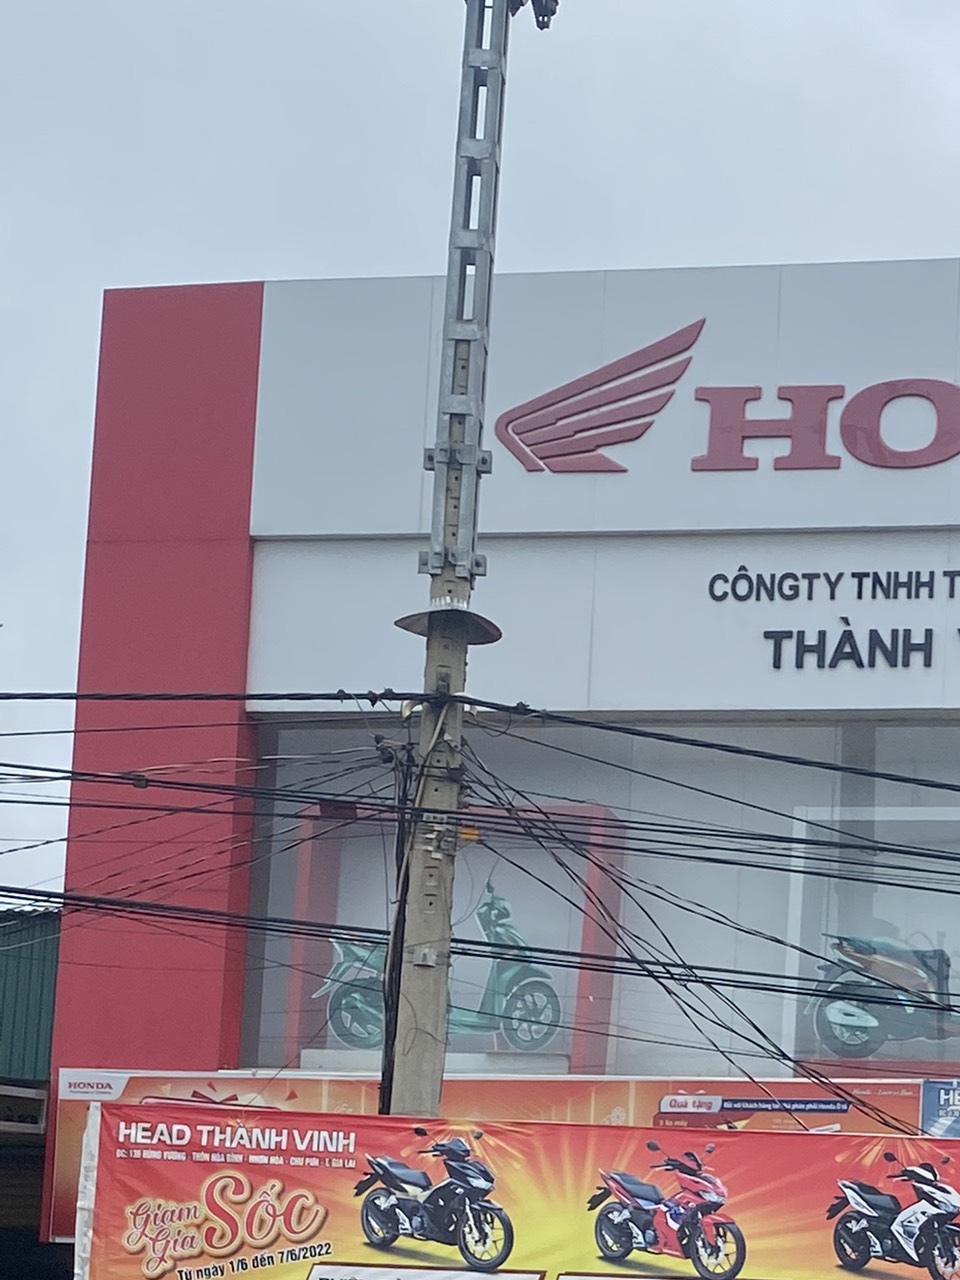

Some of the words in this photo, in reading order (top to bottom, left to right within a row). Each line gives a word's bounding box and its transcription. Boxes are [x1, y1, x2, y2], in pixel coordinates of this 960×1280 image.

[851, 571, 935, 599] TNHH
[763, 616, 933, 669] THÀNH
[68, 1081, 113, 1090] HONDA
[118, 1121, 191, 1146] HEAD
[196, 1121, 287, 1150] THÀNH
[293, 1129, 356, 1153] VINH
[195, 1262, 225, 1280] ngày
[228, 1256, 248, 1273] 1/6
[251, 1251, 275, 1269] đến
[277, 1243, 333, 1264] 7/6/2022
